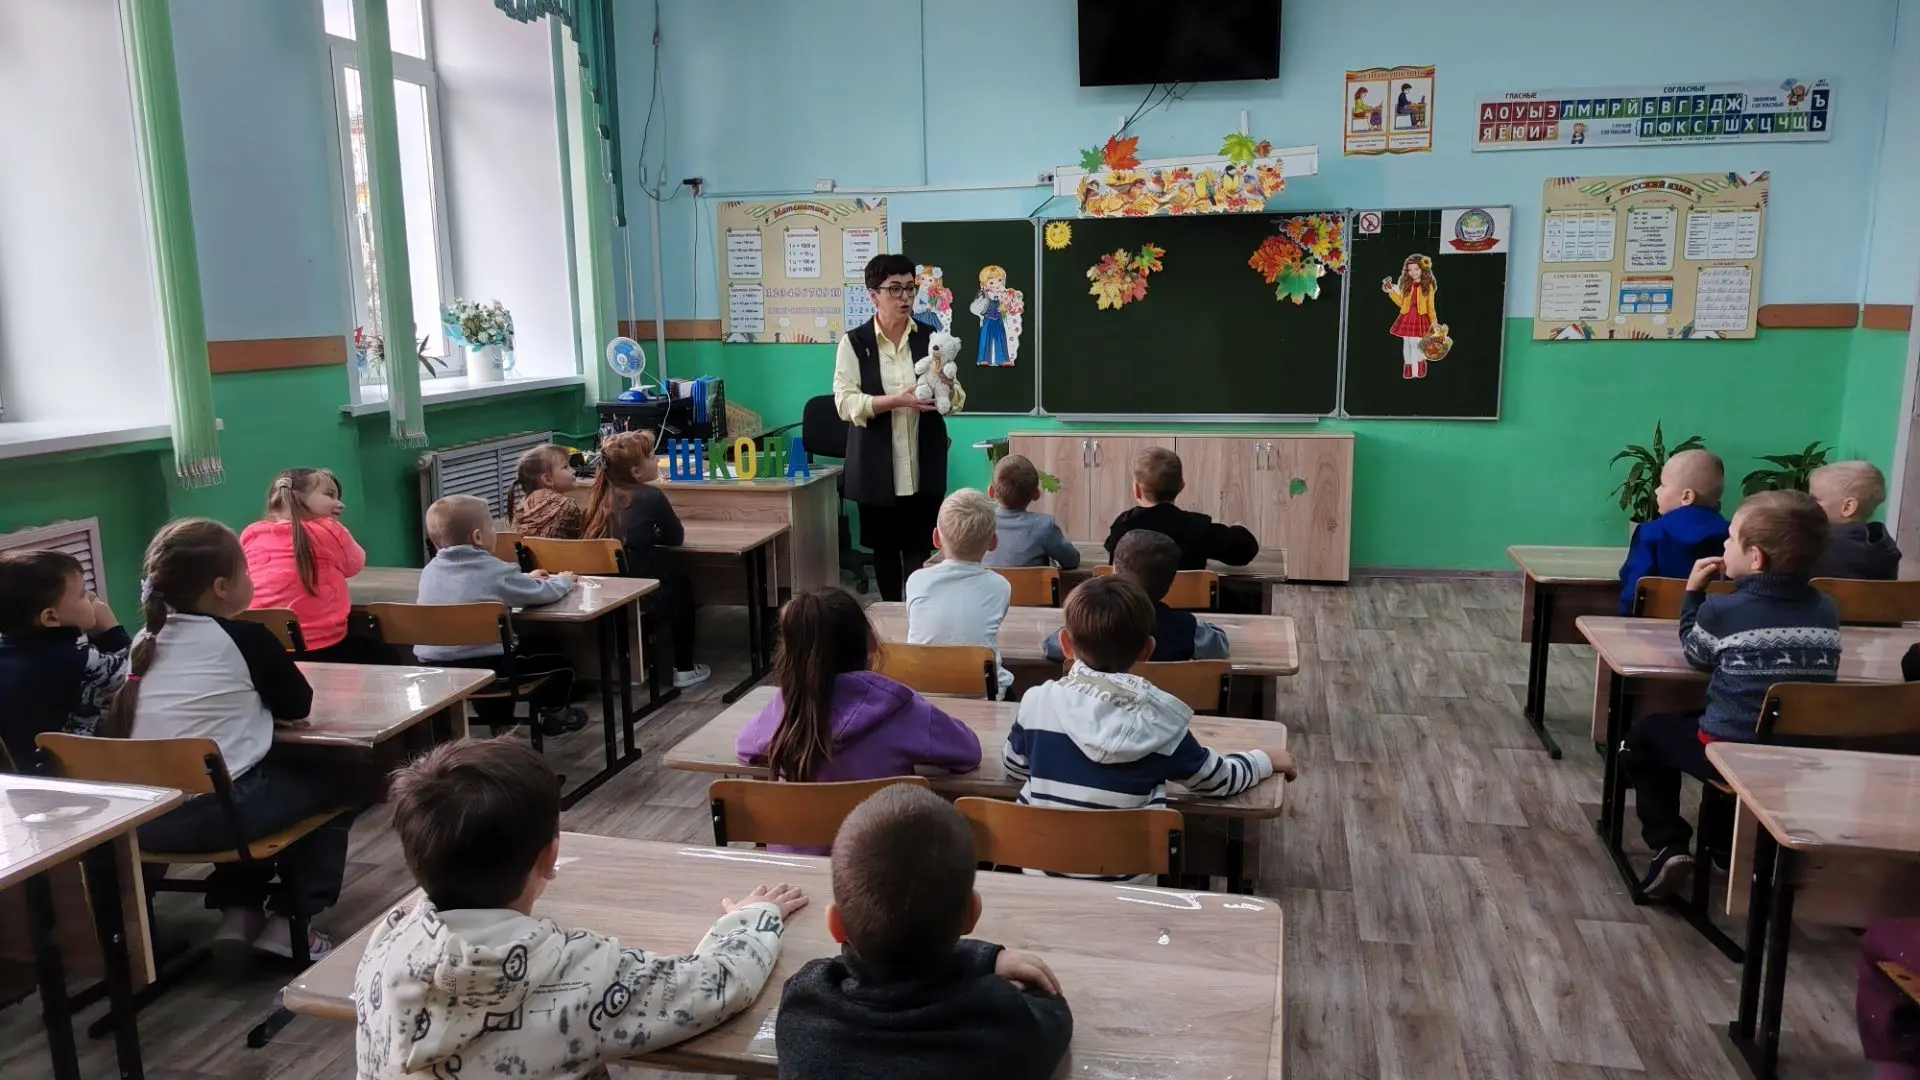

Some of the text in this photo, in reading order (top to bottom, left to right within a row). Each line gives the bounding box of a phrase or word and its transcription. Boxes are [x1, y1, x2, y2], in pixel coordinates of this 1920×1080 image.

[1664, 84, 1706, 93] СОГЛАСНЫЕ
[1620, 180, 1694, 195] РУССКИЙ ЯЗЫК
[774, 204, 830, 218] Математика
[668, 437, 810, 480] ШКОЛА
